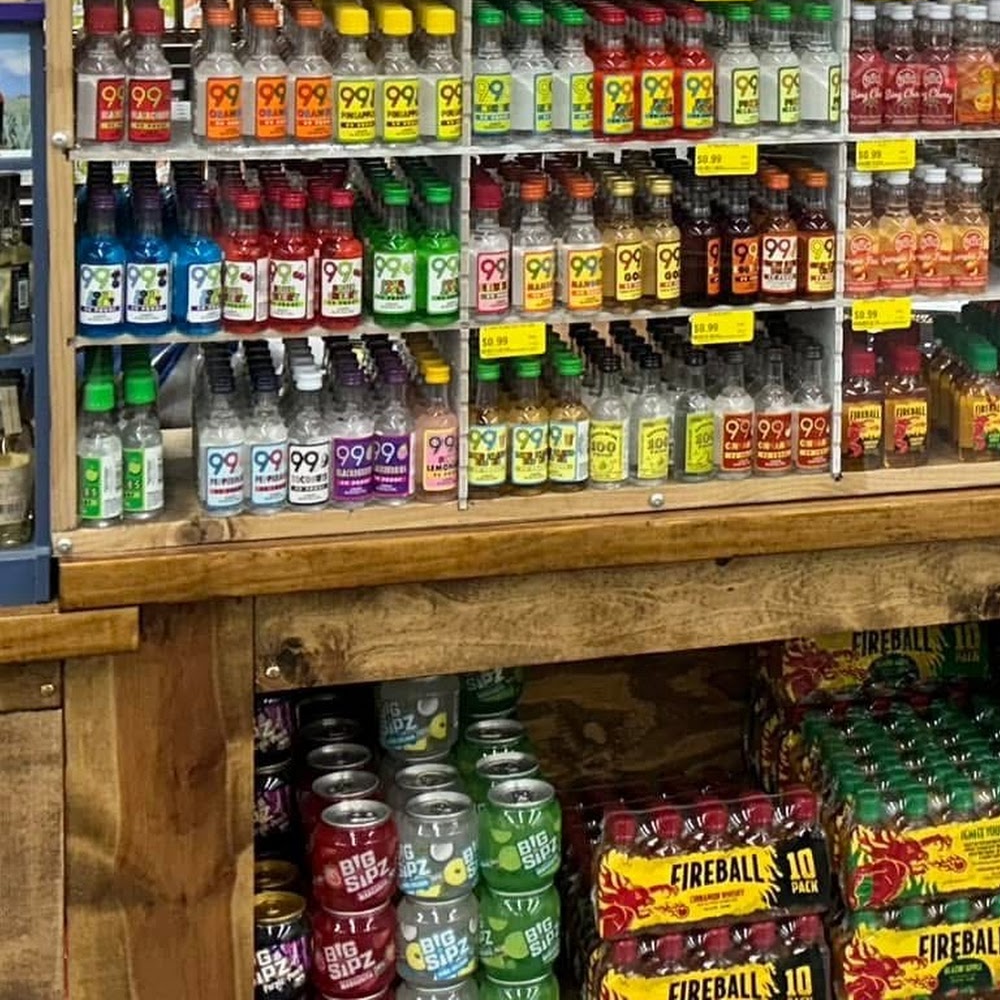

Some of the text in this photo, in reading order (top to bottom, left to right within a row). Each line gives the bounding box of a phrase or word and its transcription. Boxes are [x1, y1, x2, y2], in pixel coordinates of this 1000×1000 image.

[131, 86, 163, 108] 99
[210, 83, 240, 107] 99
[297, 83, 329, 107] 99
[340, 85, 370, 110] 99
[386, 85, 416, 110] 99
[764, 238, 795, 262] 99
[480, 256, 506, 280] 99
[850, 409, 882, 421] FIREBALL
[895, 406, 927, 417] FIREBALL
[725, 418, 751, 438] 99
[757, 418, 784, 439] 99
[800, 416, 827, 439] 99
[208, 451, 239, 476] 99
[254, 449, 283, 474] 99
[290, 450, 318, 473] 99
[336, 445, 365, 467] 99
[853, 624, 981, 657] FIREBALL 10
[671, 847, 817, 893] FIREBALL 10
[790, 879, 819, 895] PACK
[669, 965, 812, 1000] FIREBALL 10
